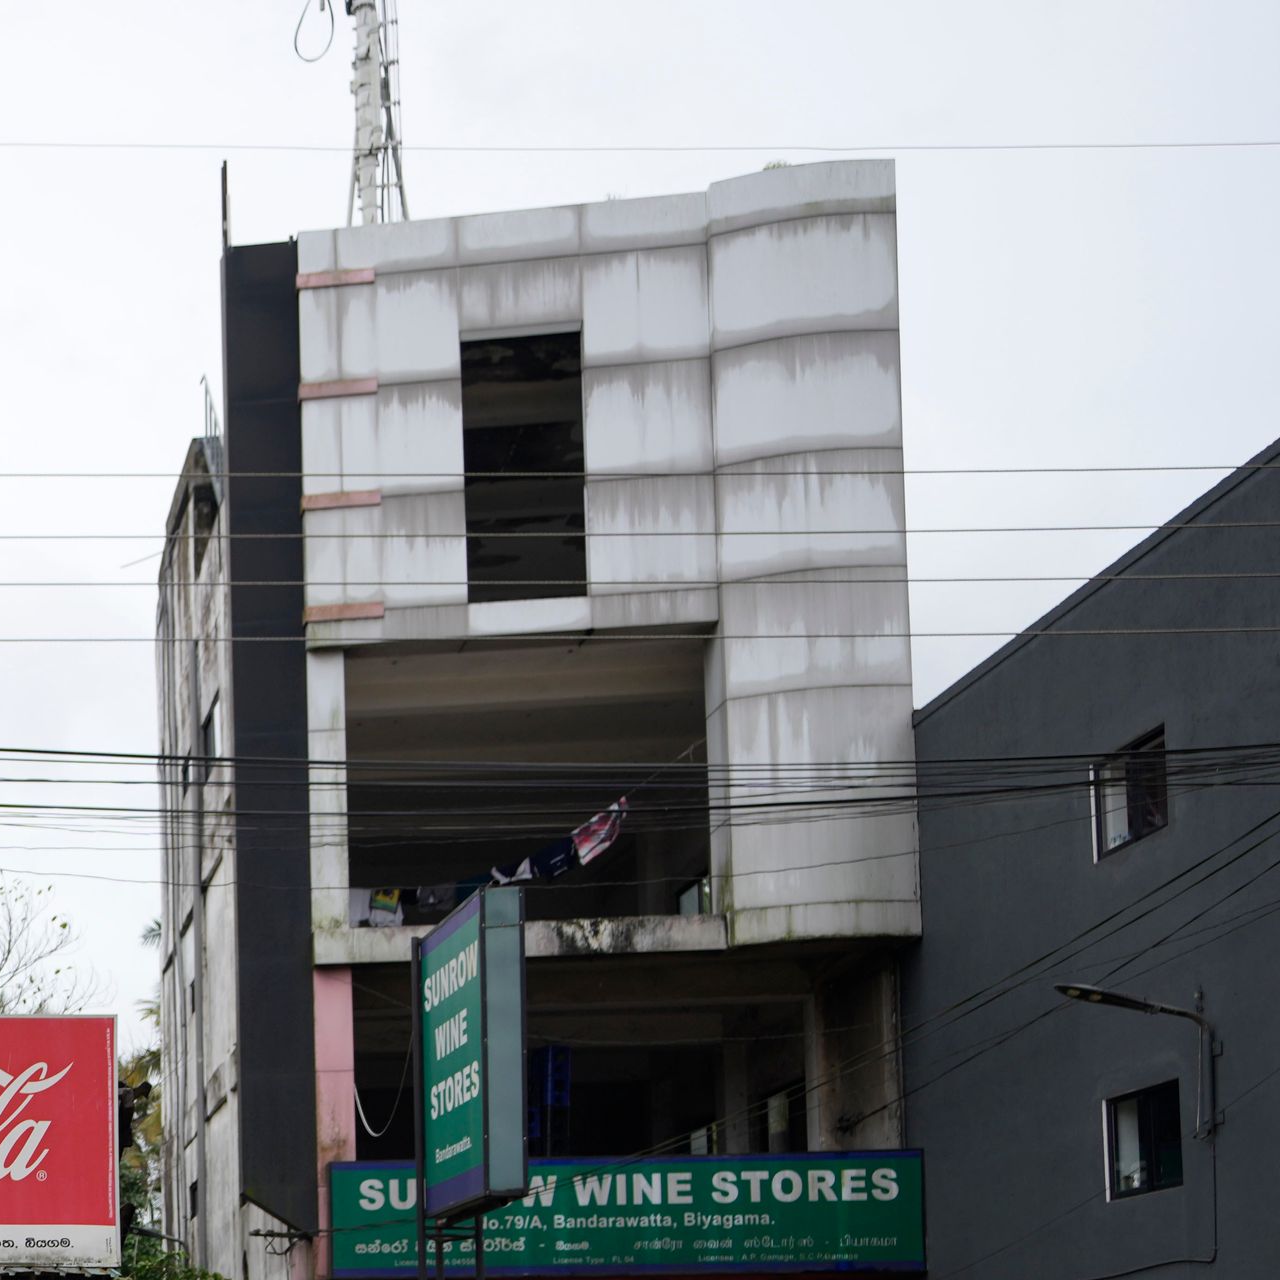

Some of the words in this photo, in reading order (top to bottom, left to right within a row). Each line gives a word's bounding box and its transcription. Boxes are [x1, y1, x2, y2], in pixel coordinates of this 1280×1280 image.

[424, 940, 479, 1012] SUNROW
[435, 1008, 468, 1061] WINE
[430, 1060, 480, 1121] STORES
[359, 1174, 558, 1211] SUW
[573, 1171, 694, 1207] WINE
[712, 1168, 900, 1204] STORES
[554, 1212, 678, 1231] Bandarawatta,
[683, 1211, 776, 1230] Biyagama.
